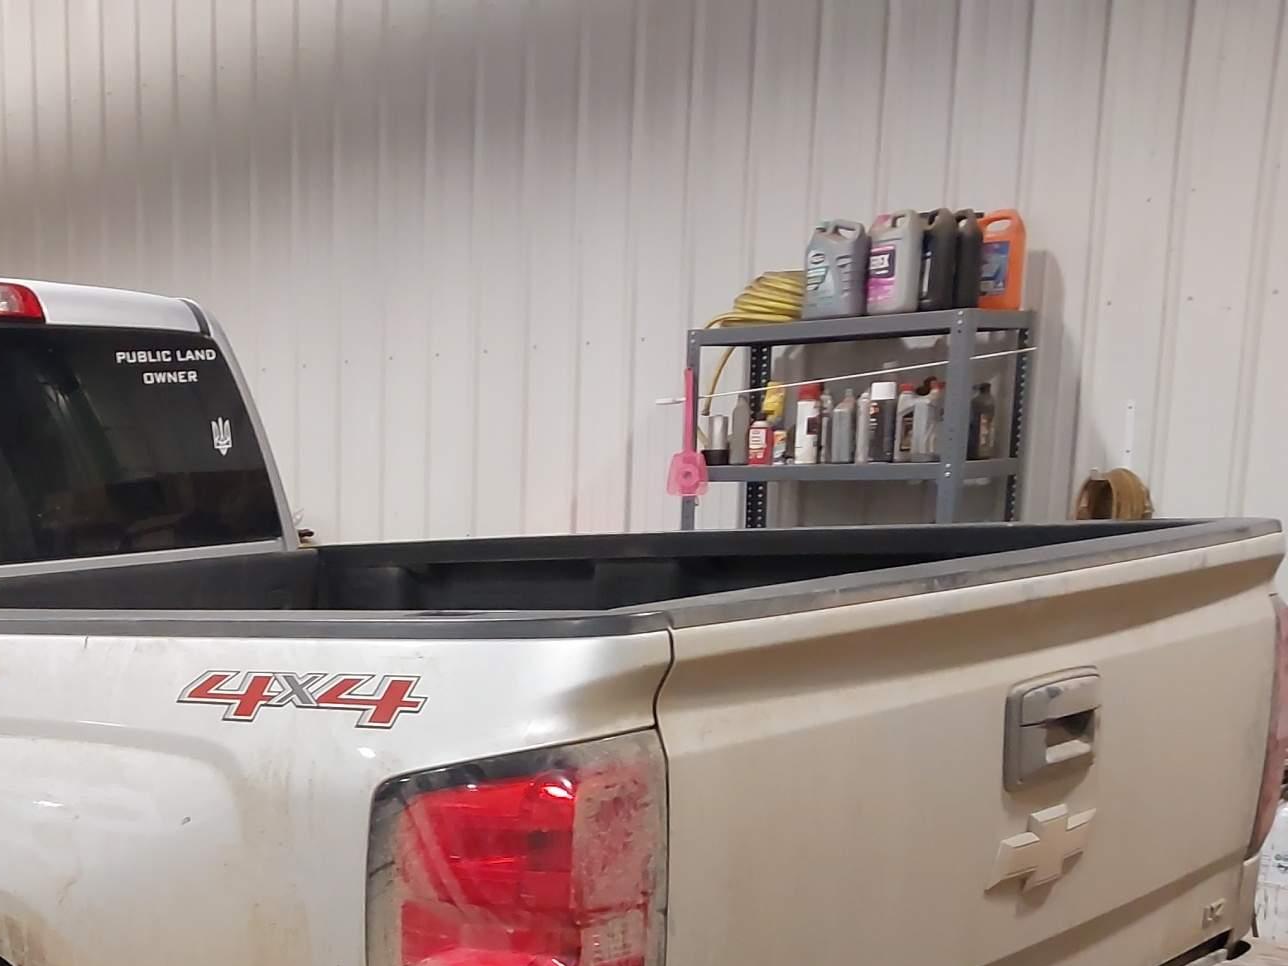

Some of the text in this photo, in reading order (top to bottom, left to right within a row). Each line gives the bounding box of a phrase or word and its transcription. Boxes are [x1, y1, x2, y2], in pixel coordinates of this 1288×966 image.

[115, 349, 217, 364] PUBLIC LAND
[143, 370, 198, 385] OWNER
